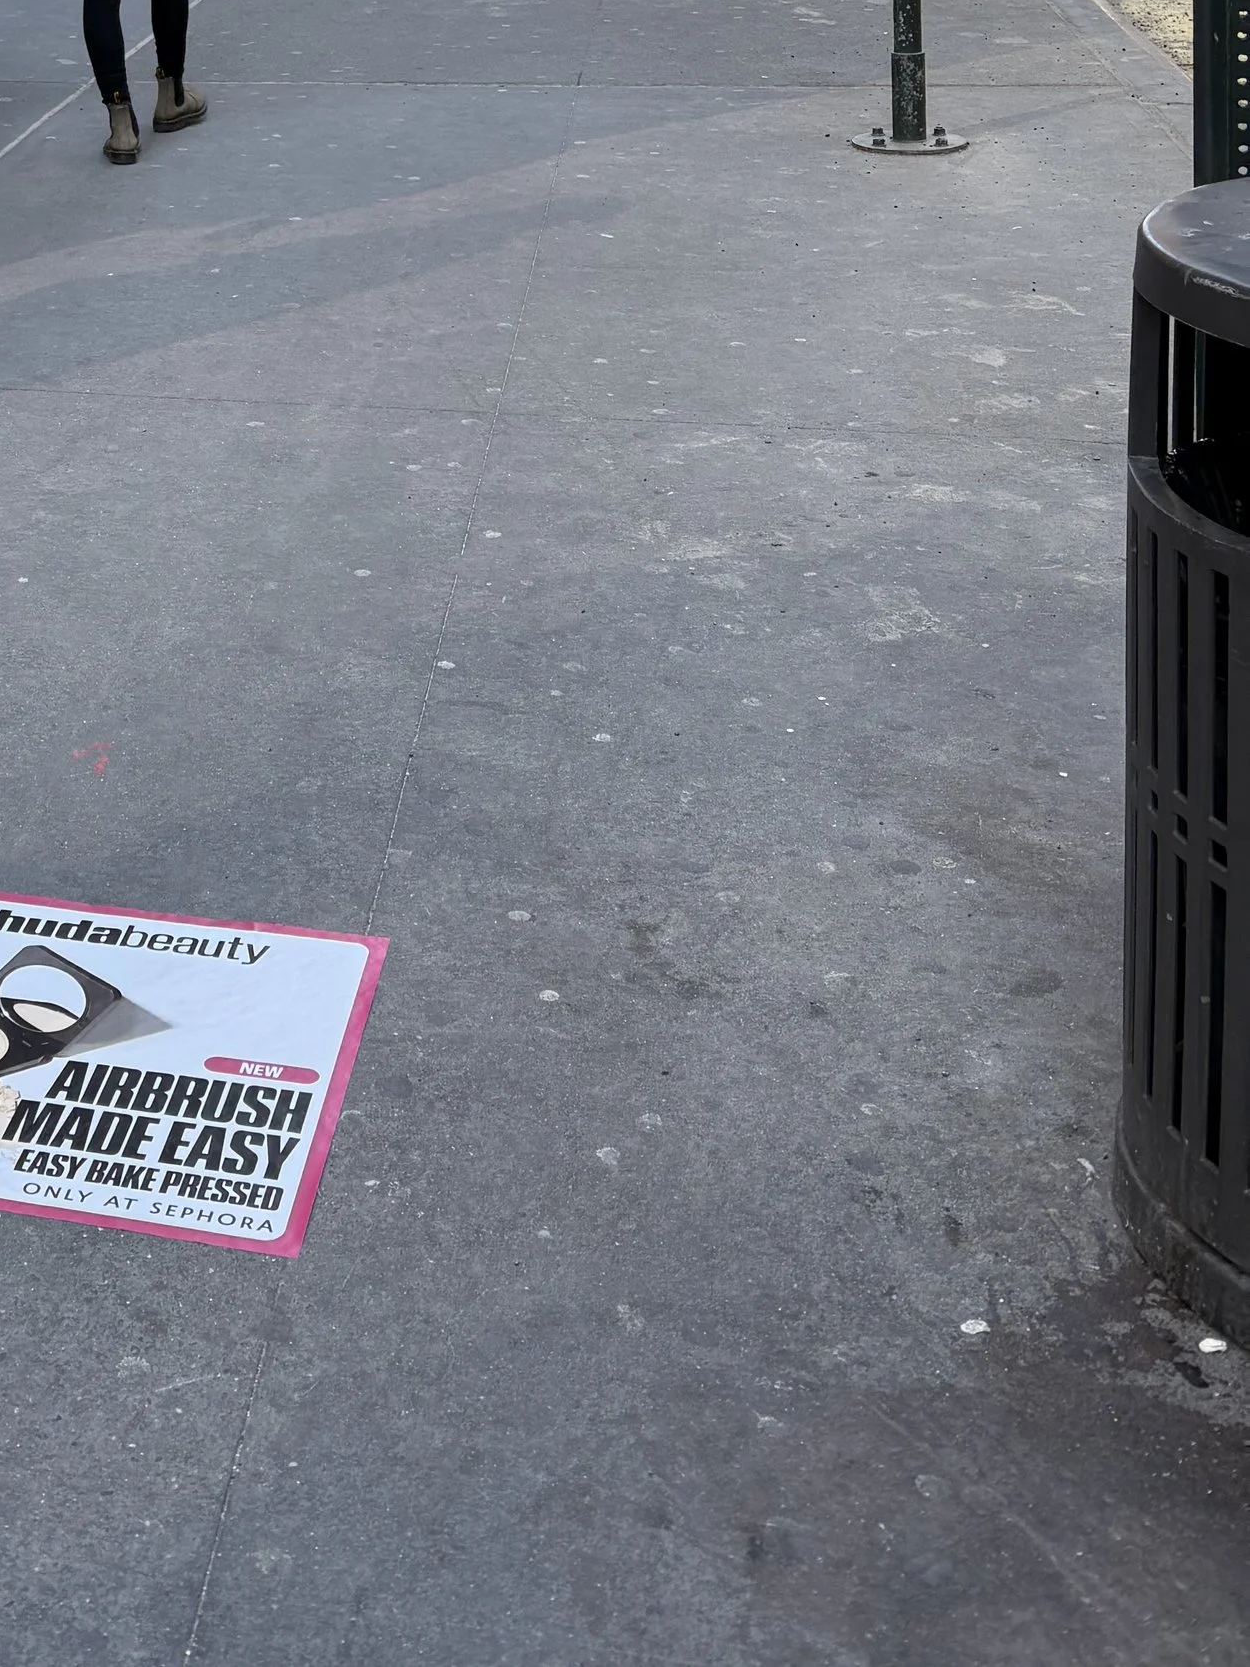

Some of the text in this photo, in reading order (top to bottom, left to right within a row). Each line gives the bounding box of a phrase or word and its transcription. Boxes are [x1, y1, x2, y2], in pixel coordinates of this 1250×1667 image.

[45, 1060, 314, 1133] AIRBRUSH
[239, 1062, 284, 1079] NEW
[1, 1099, 301, 1180] MADE EASY
[13, 1149, 284, 1211] EASY BAKE PRESSED
[23, 1182, 274, 1233] ONLY AT SEPHORA
